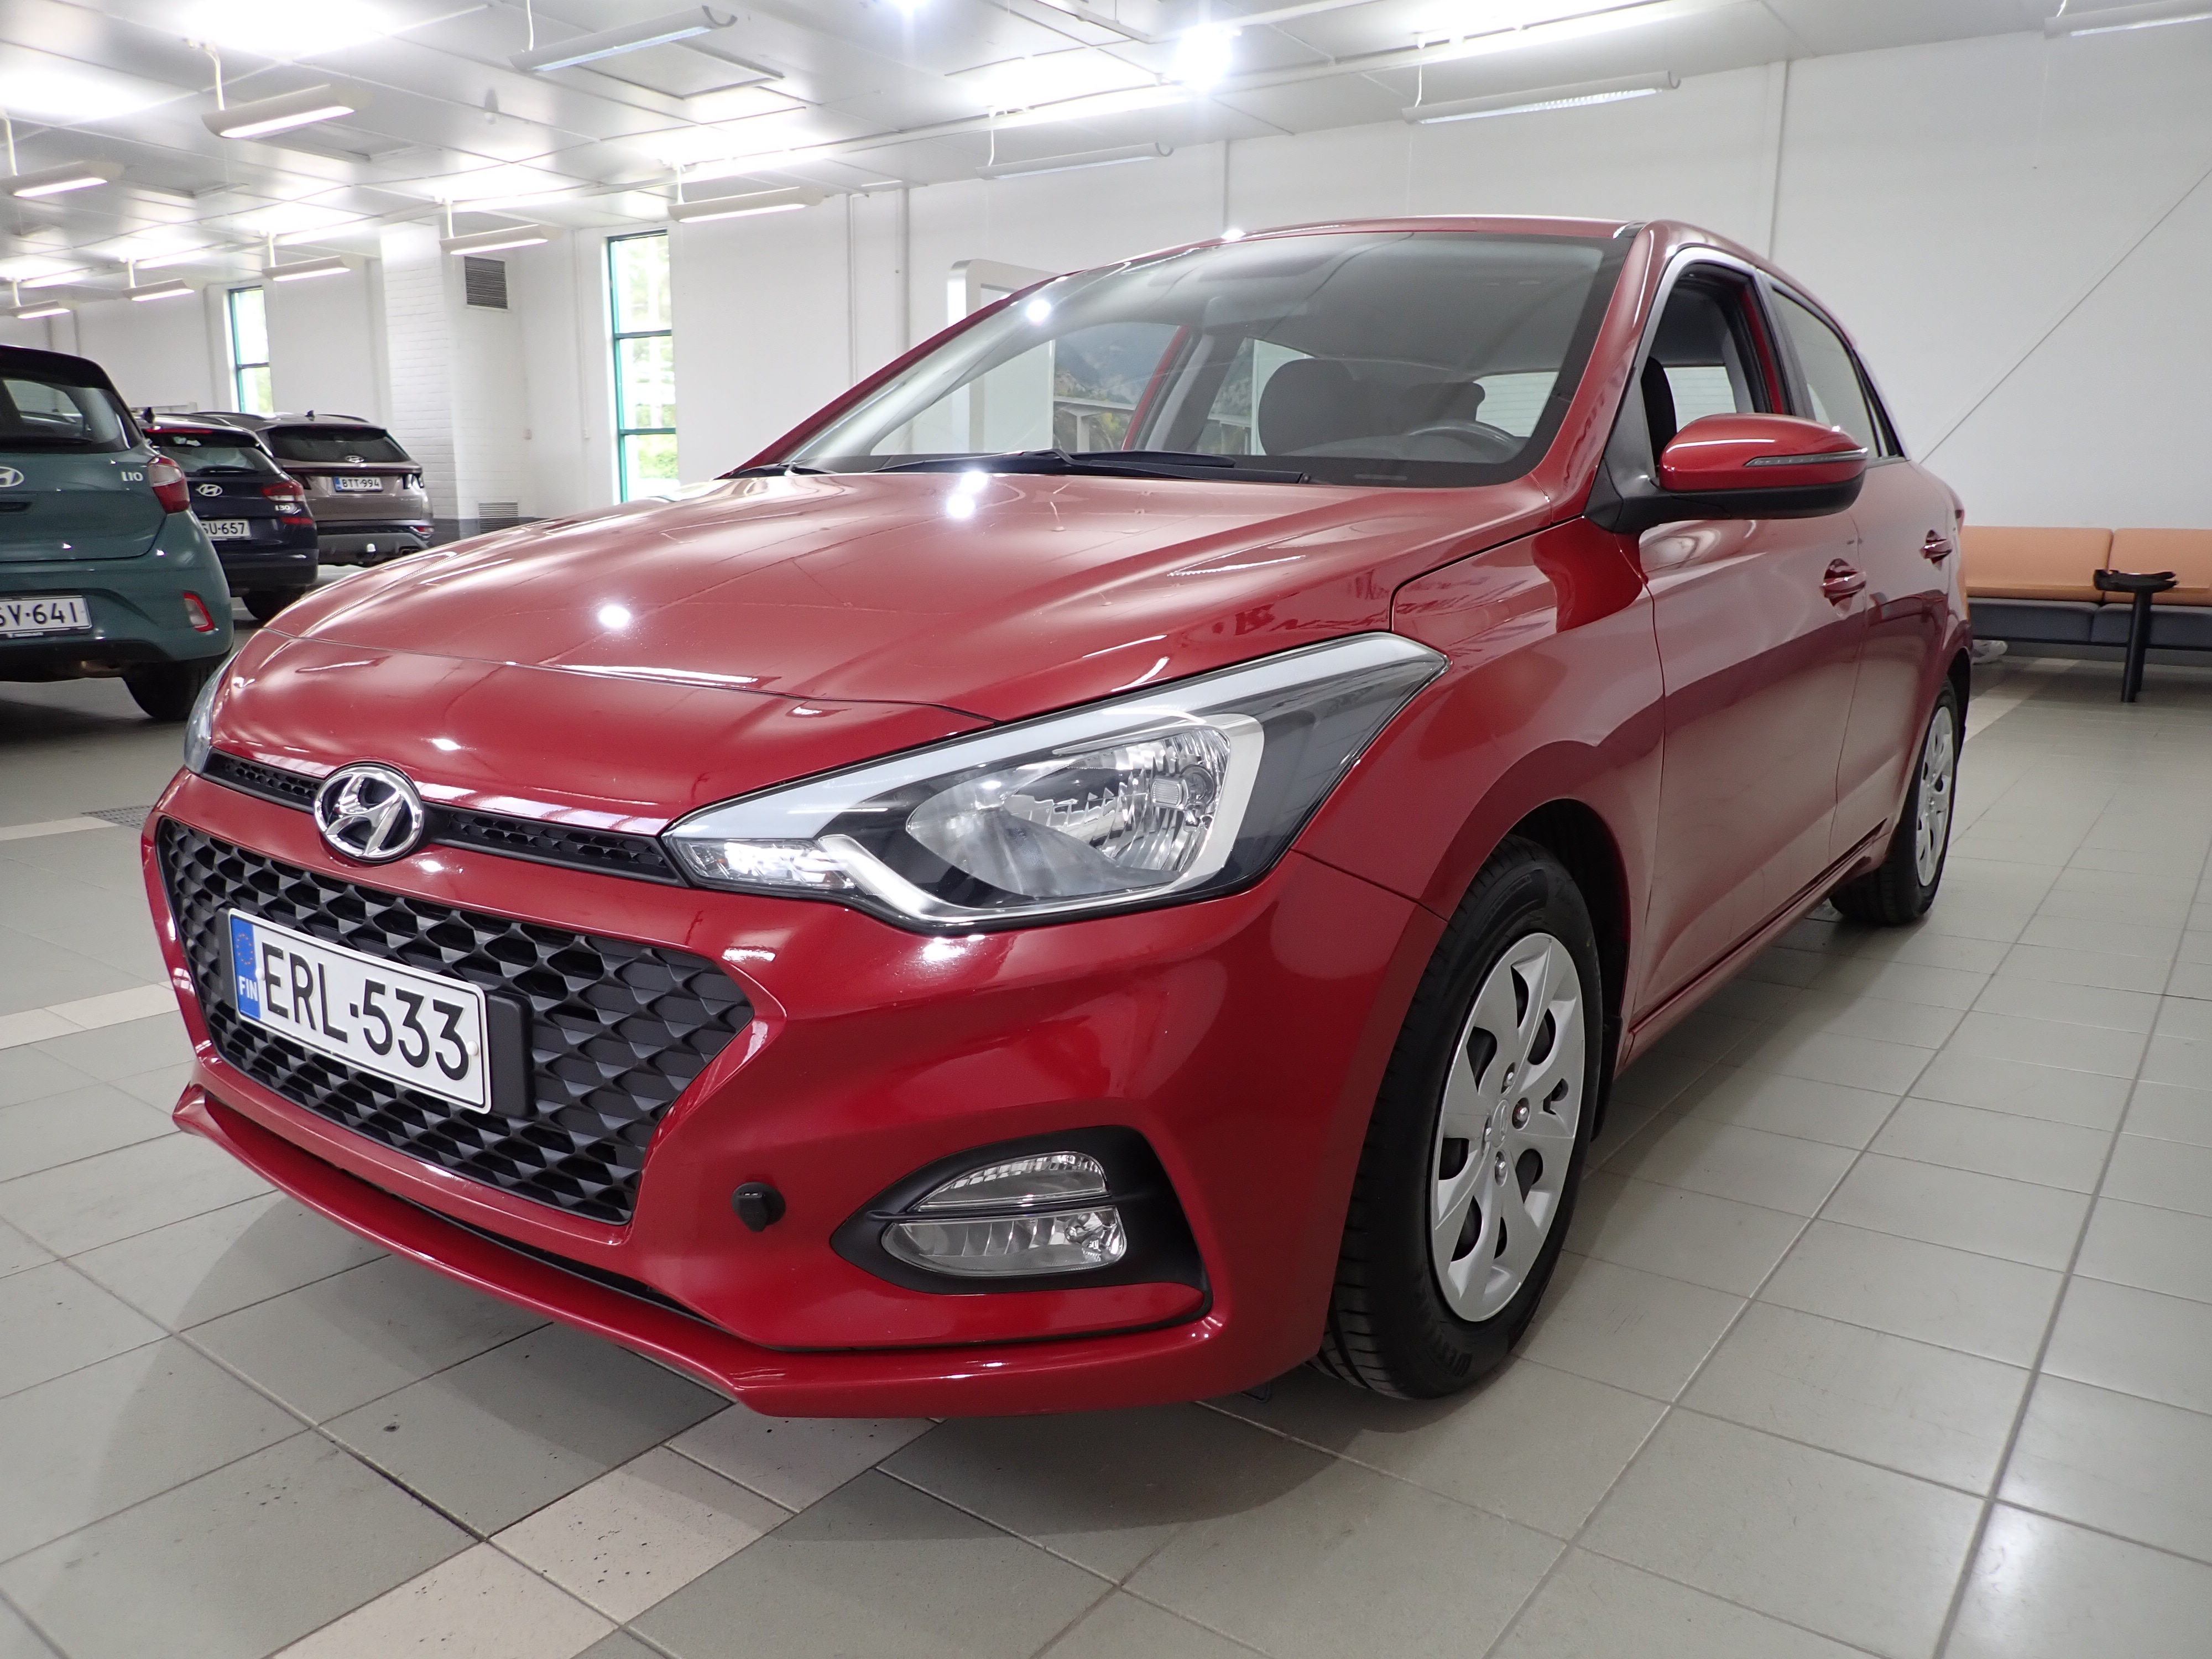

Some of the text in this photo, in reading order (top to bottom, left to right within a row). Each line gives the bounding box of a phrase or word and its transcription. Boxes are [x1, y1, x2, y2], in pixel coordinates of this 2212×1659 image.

[342, 479, 379, 487] BTT-994
[238, 975, 259, 1001] FIN
[262, 941, 469, 1081] ERL-533
